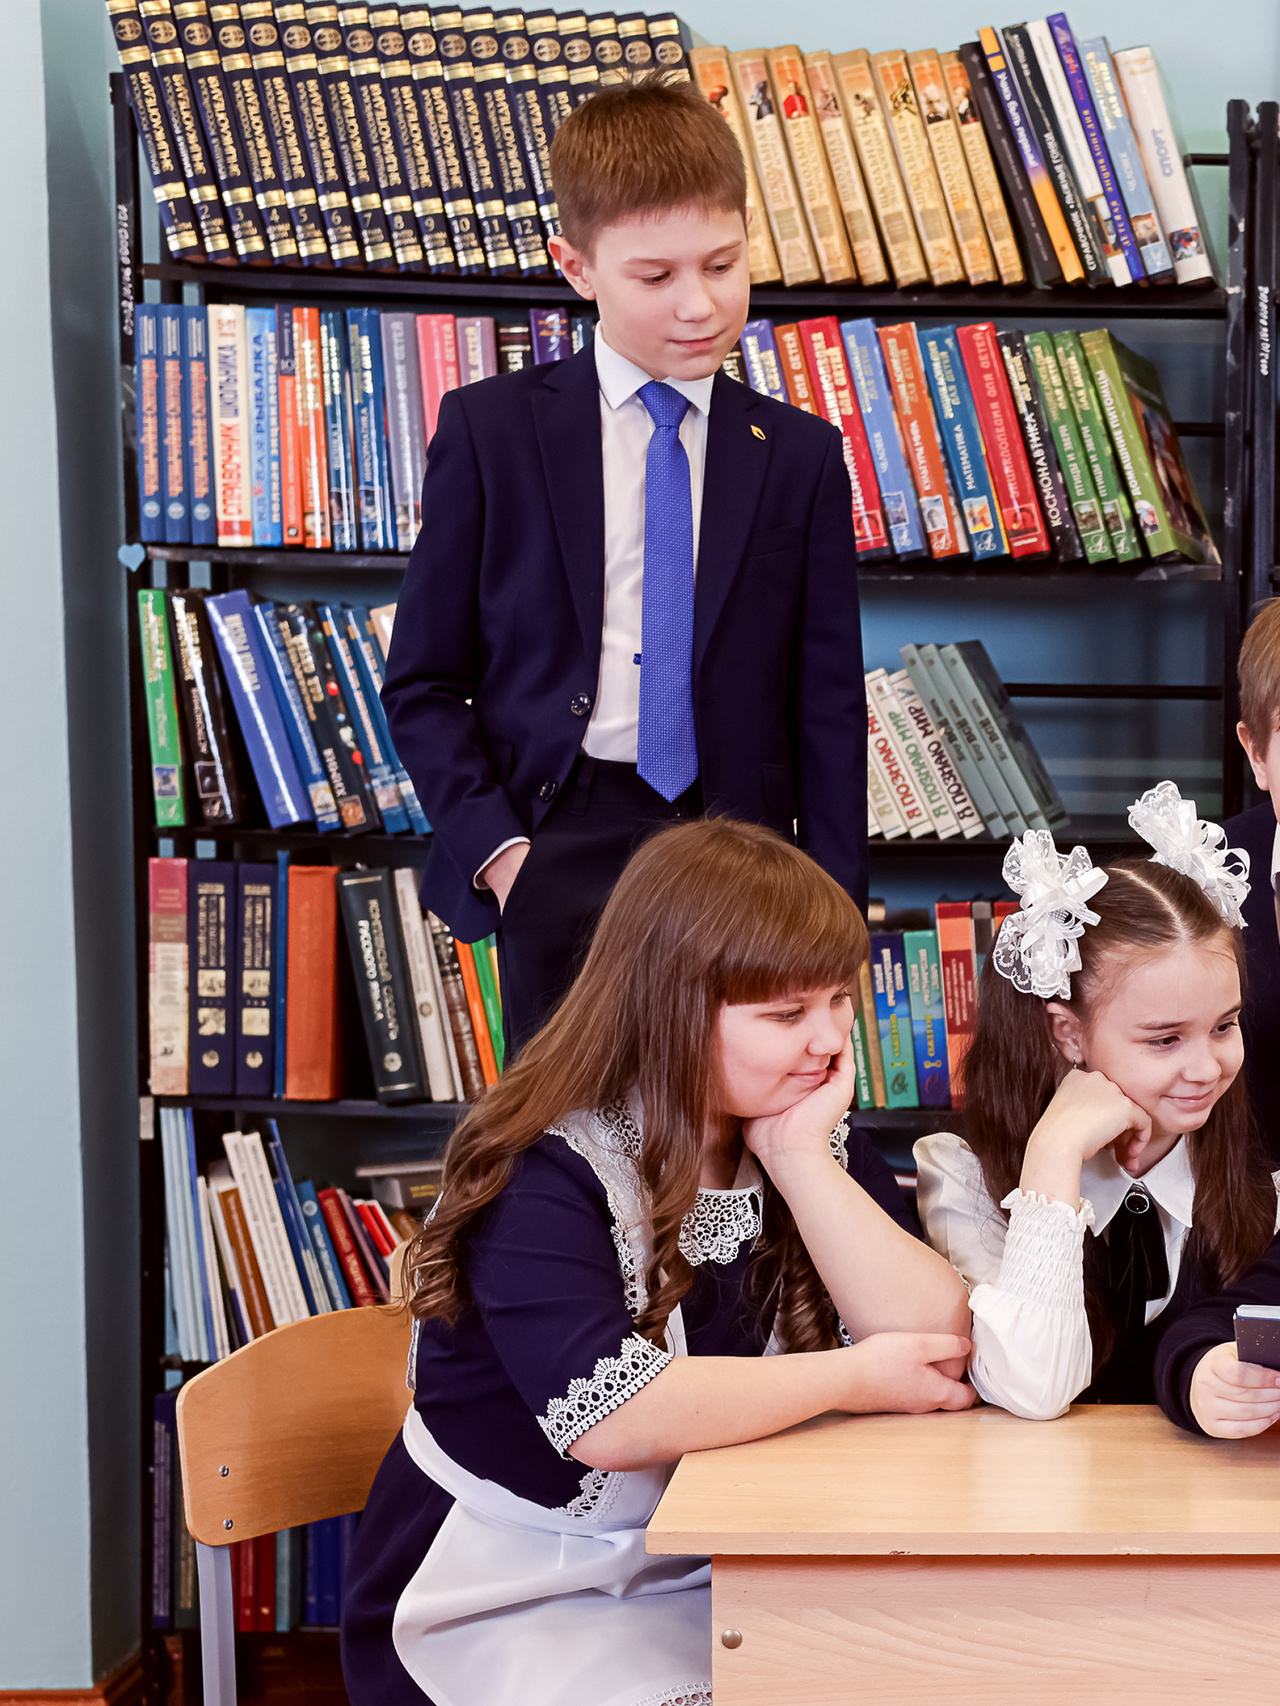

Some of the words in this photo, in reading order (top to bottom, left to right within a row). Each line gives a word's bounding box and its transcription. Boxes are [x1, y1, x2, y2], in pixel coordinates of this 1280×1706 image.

[138, 70, 174, 173] ЭНЦИКЛОПЕДИЯ
[171, 72, 207, 175] ЭНЦИКЛОПЕДИЯ
[206, 74, 242, 177] ЭНЦИКЛОПЕДИЯ
[240, 76, 277, 180] ЭНЦИКЛОПЕДИЯ
[270, 75, 307, 179] ЭНЦИКЛОПЕДИЯ
[303, 77, 340, 181] ЭНЦИКЛОПЕДИЯ
[335, 80, 372, 184] ЭНЦИКЛОПЕДИЯ
[366, 81, 404, 186] ЭНЦИКЛОПЕДИЯ
[397, 84, 435, 188] ЭНЦИКЛОПЕДИЯ
[428, 85, 465, 189] ЭНЦИКЛОПЕДИЯ
[460, 86, 496, 189] ЭНЦИКЛОПЕДИЯ
[491, 87, 528, 190] ЭНЦИКЛОПЕДИЯ
[1043, 130, 1060, 163] ГОНКИ
[1082, 107, 1114, 192] ЭНЦИКЛОПЕДИЯ
[1150, 129, 1174, 177] СПОРТ
[1118, 150, 1138, 191] ЧЕЛОВЕК
[168, 201, 176, 215] 1
[200, 205, 210, 220] 2
[236, 207, 244, 221] 3
[270, 208, 280, 223] 4
[298, 208, 308, 222] 5
[331, 210, 342, 225] 6
[364, 213, 373, 228] 7
[393, 215, 404, 230] 8
[425, 217, 435, 232] 9
[452, 217, 470, 234] 10
[483, 218, 499, 234] 11
[515, 219, 533, 235] 12
[546, 220, 563, 236] 13
[1110, 198, 1131, 248] ДЕТСКАЯ
[1070, 209, 1097, 271] СПРАВОЧНИК
[441, 322, 456, 361] ДЕТЕЙ
[464, 325, 479, 365] ДЕТЕЙ
[784, 331, 803, 370] ДЕТЕЙ
[971, 329, 990, 370] ДЕТЕЙ
[216, 343, 240, 417] ШКОЛЬНИКА
[250, 334, 267, 432] РЫБАЛКА
[794, 372, 809, 398] ДЛЯ
[827, 345, 848, 387] ДЕТЕЙ
[927, 339, 953, 419] ЭНЦИКЛОПЕДИЯ
[939, 350, 955, 383] ДЕТЕЙ
[982, 373, 997, 399] ДЛЯ
[1032, 344, 1059, 422] ЭНЦИКЛОПЕДИЯ
[1044, 352, 1061, 388] ДЕТЕЙ
[1066, 354, 1084, 389] ДЕТЕЙ
[836, 388, 853, 417] ДЛЯ
[947, 384, 960, 406] ДЛЯ
[1053, 387, 1066, 410] ДЛЯ
[1075, 388, 1090, 411] ДЛЯ
[1094, 368, 1120, 428] ПИТОМЦЫ
[359, 406, 372, 481] ИНФОРМАТИКА
[872, 431, 889, 473] ЧЕЛОВЕК
[908, 420, 922, 446] МИРА
[989, 400, 1019, 499] ЭНЦИКЛОПЕДИЯ
[1058, 423, 1073, 453] ЗВЕРИ
[1080, 424, 1096, 453] ЗВЕРИ
[218, 421, 244, 515] СПРАВОЧНИК
[913, 446, 931, 490] КУЛЬТУРЫ
[952, 423, 975, 490] МАТЕМАТИКА
[1022, 410, 1063, 529] КОСМОНАВТИКА
[1066, 452, 1076, 462] И
[1088, 453, 1098, 463] И
[1113, 428, 1143, 497] ДОМАШНИЕ
[1069, 464, 1087, 496] ПТИЦЫ
[1091, 465, 1108, 497] ПТИЦЫ
[190, 686, 208, 754] АСТРОНОМИЯ
[886, 707, 914, 743] МИР
[905, 701, 936, 739] МИР
[322, 746, 346, 798] ХИМИЯ
[870, 736, 919, 808] ПОЗНАЮ
[901, 741, 945, 805] ПОЗНАЮ
[922, 737, 971, 806] ПОЗНАЮ
[875, 801, 894, 819] Я
[905, 805, 922, 821] Я
[931, 802, 950, 820] Я
[957, 804, 975, 821] Я
[357, 919, 377, 979] РУССКОГО
